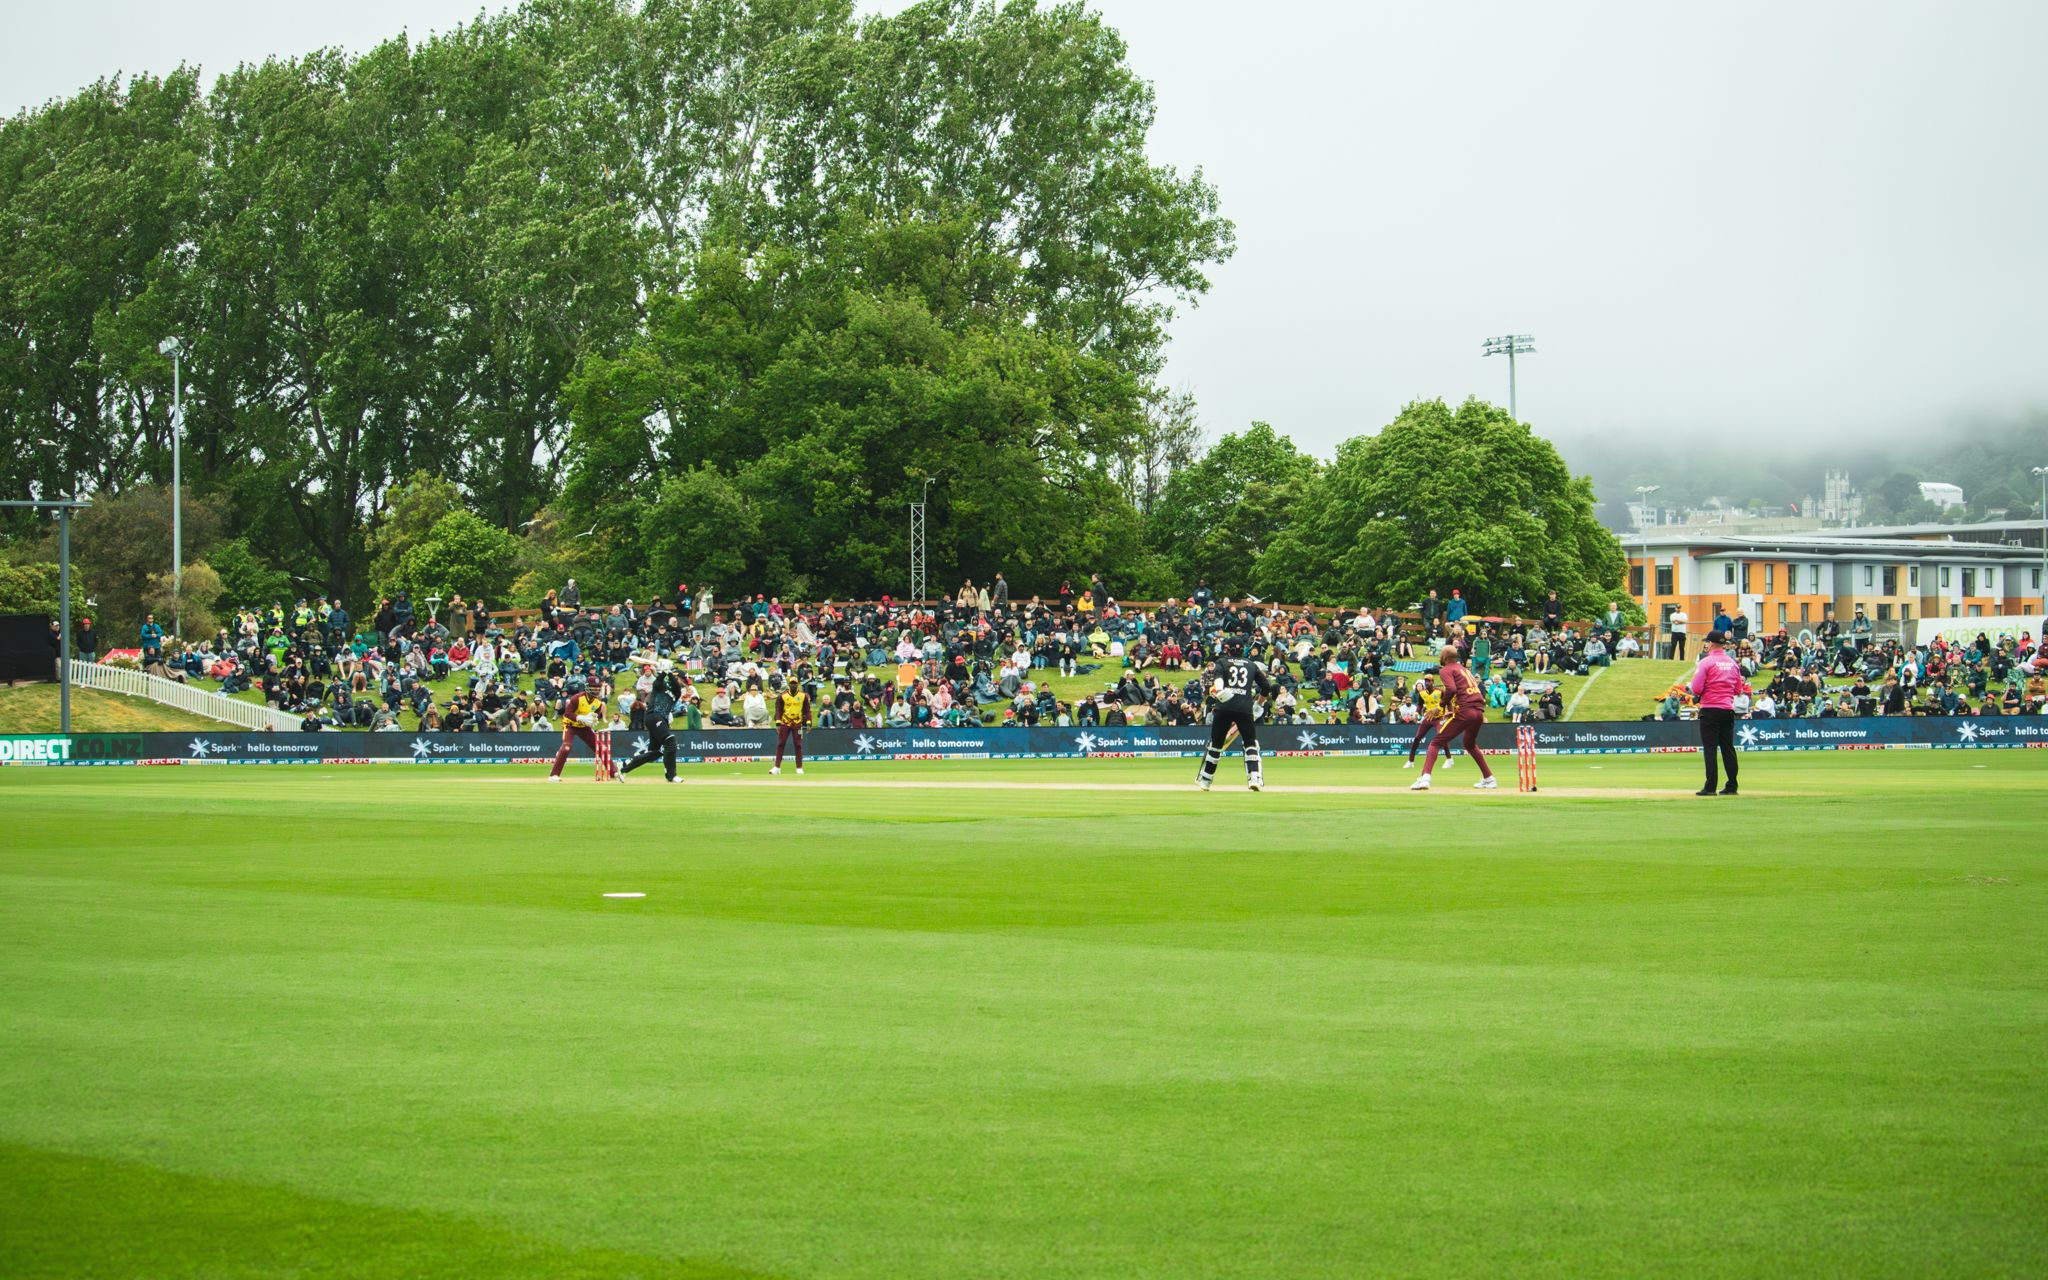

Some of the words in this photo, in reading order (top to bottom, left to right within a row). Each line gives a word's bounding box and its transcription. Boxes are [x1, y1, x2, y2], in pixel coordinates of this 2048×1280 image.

[1228, 666, 1248, 687] 33
[1759, 730, 1785, 739] Spark
[1795, 729, 1819, 738] hello
[1820, 730, 1867, 738] tomorrow
[1979, 727, 2005, 737] Spark
[2015, 726, 2038, 735] hello
[1097, 737, 1124, 747] Spark
[1134, 737, 1157, 746] hello
[1159, 738, 1205, 746] tomorrow
[1319, 735, 1345, 745] Spark
[1355, 735, 1378, 744] hello
[1539, 733, 1565, 743] Spark
[1575, 733, 1598, 742] hello
[1599, 733, 1646, 742] tomorrow
[211, 744, 236, 754] Spark
[247, 743, 271, 752] hello
[273, 743, 319, 752] tomorrow
[433, 743, 459, 753] Spark
[469, 743, 493, 752] hello
[494, 743, 541, 752] tomorrow
[690, 741, 714, 750] hello
[716, 741, 762, 750] tomorrow
[876, 739, 902, 749] Spark
[912, 739, 936, 748] hello
[937, 739, 984, 748] tomorrow
